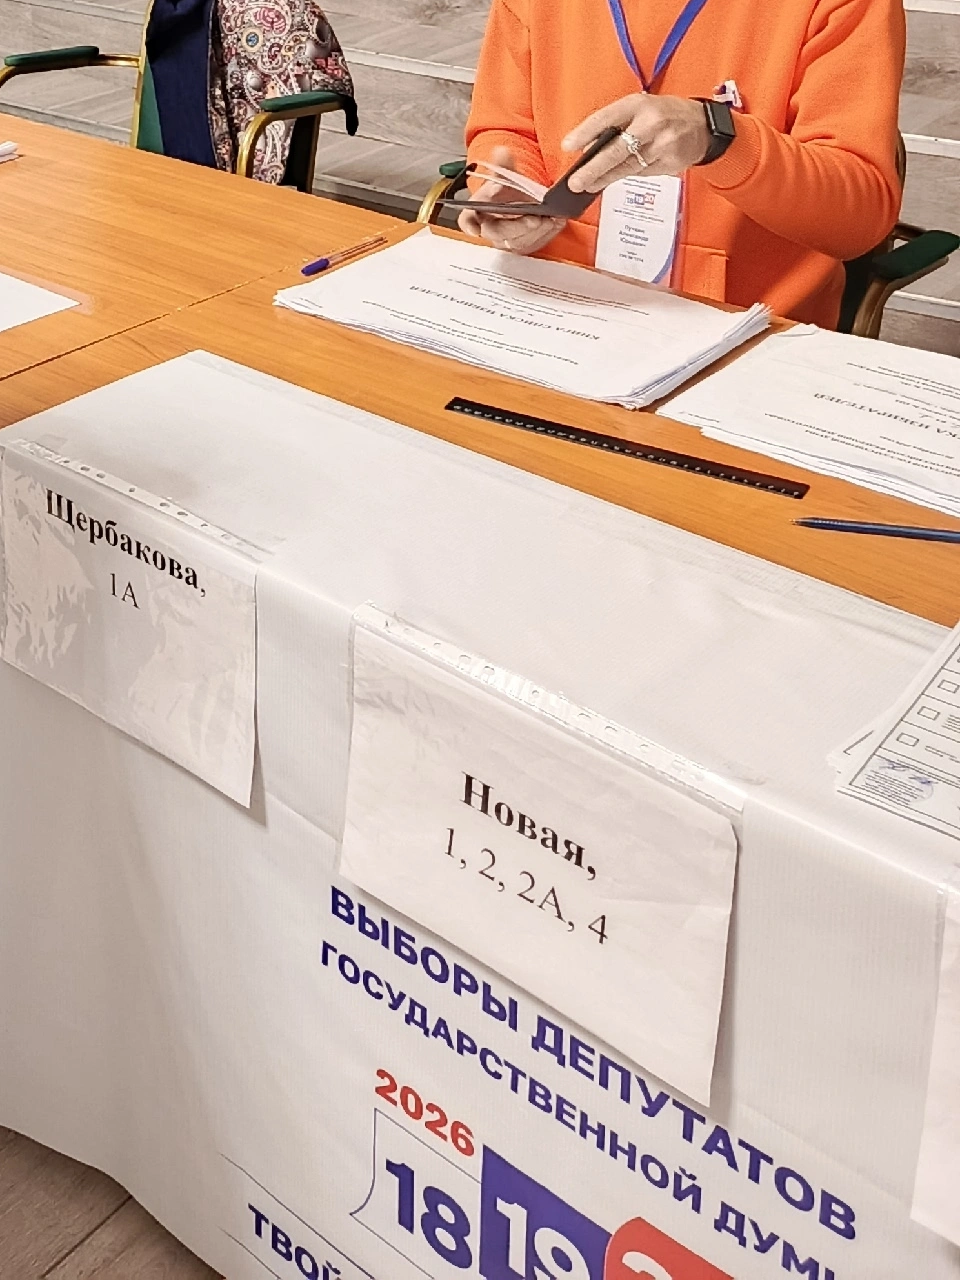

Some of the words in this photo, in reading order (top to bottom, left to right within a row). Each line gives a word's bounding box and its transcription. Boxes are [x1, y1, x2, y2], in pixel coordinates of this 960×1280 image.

[46, 488, 206, 598] Щербакова,
[110, 572, 141, 610] 1А
[460, 770, 596, 881] Новая,
[444, 827, 467, 869] 1,
[478, 847, 505, 892] 2,
[516, 870, 575, 932] 2А,
[587, 914, 609, 945] 4
[321, 939, 703, 1215] ГОСУДАРСТВЕННОЙ
[713, 1200, 836, 1280] ДУМ
[331, 884, 518, 1032] ВЫБОРЫ
[531, 1014, 857, 1240] ДЕПУТАТОВ
[374, 1067, 475, 1157] 2026
[385, 1157, 473, 1270] 18
[495, 1196, 592, 1280] 19
